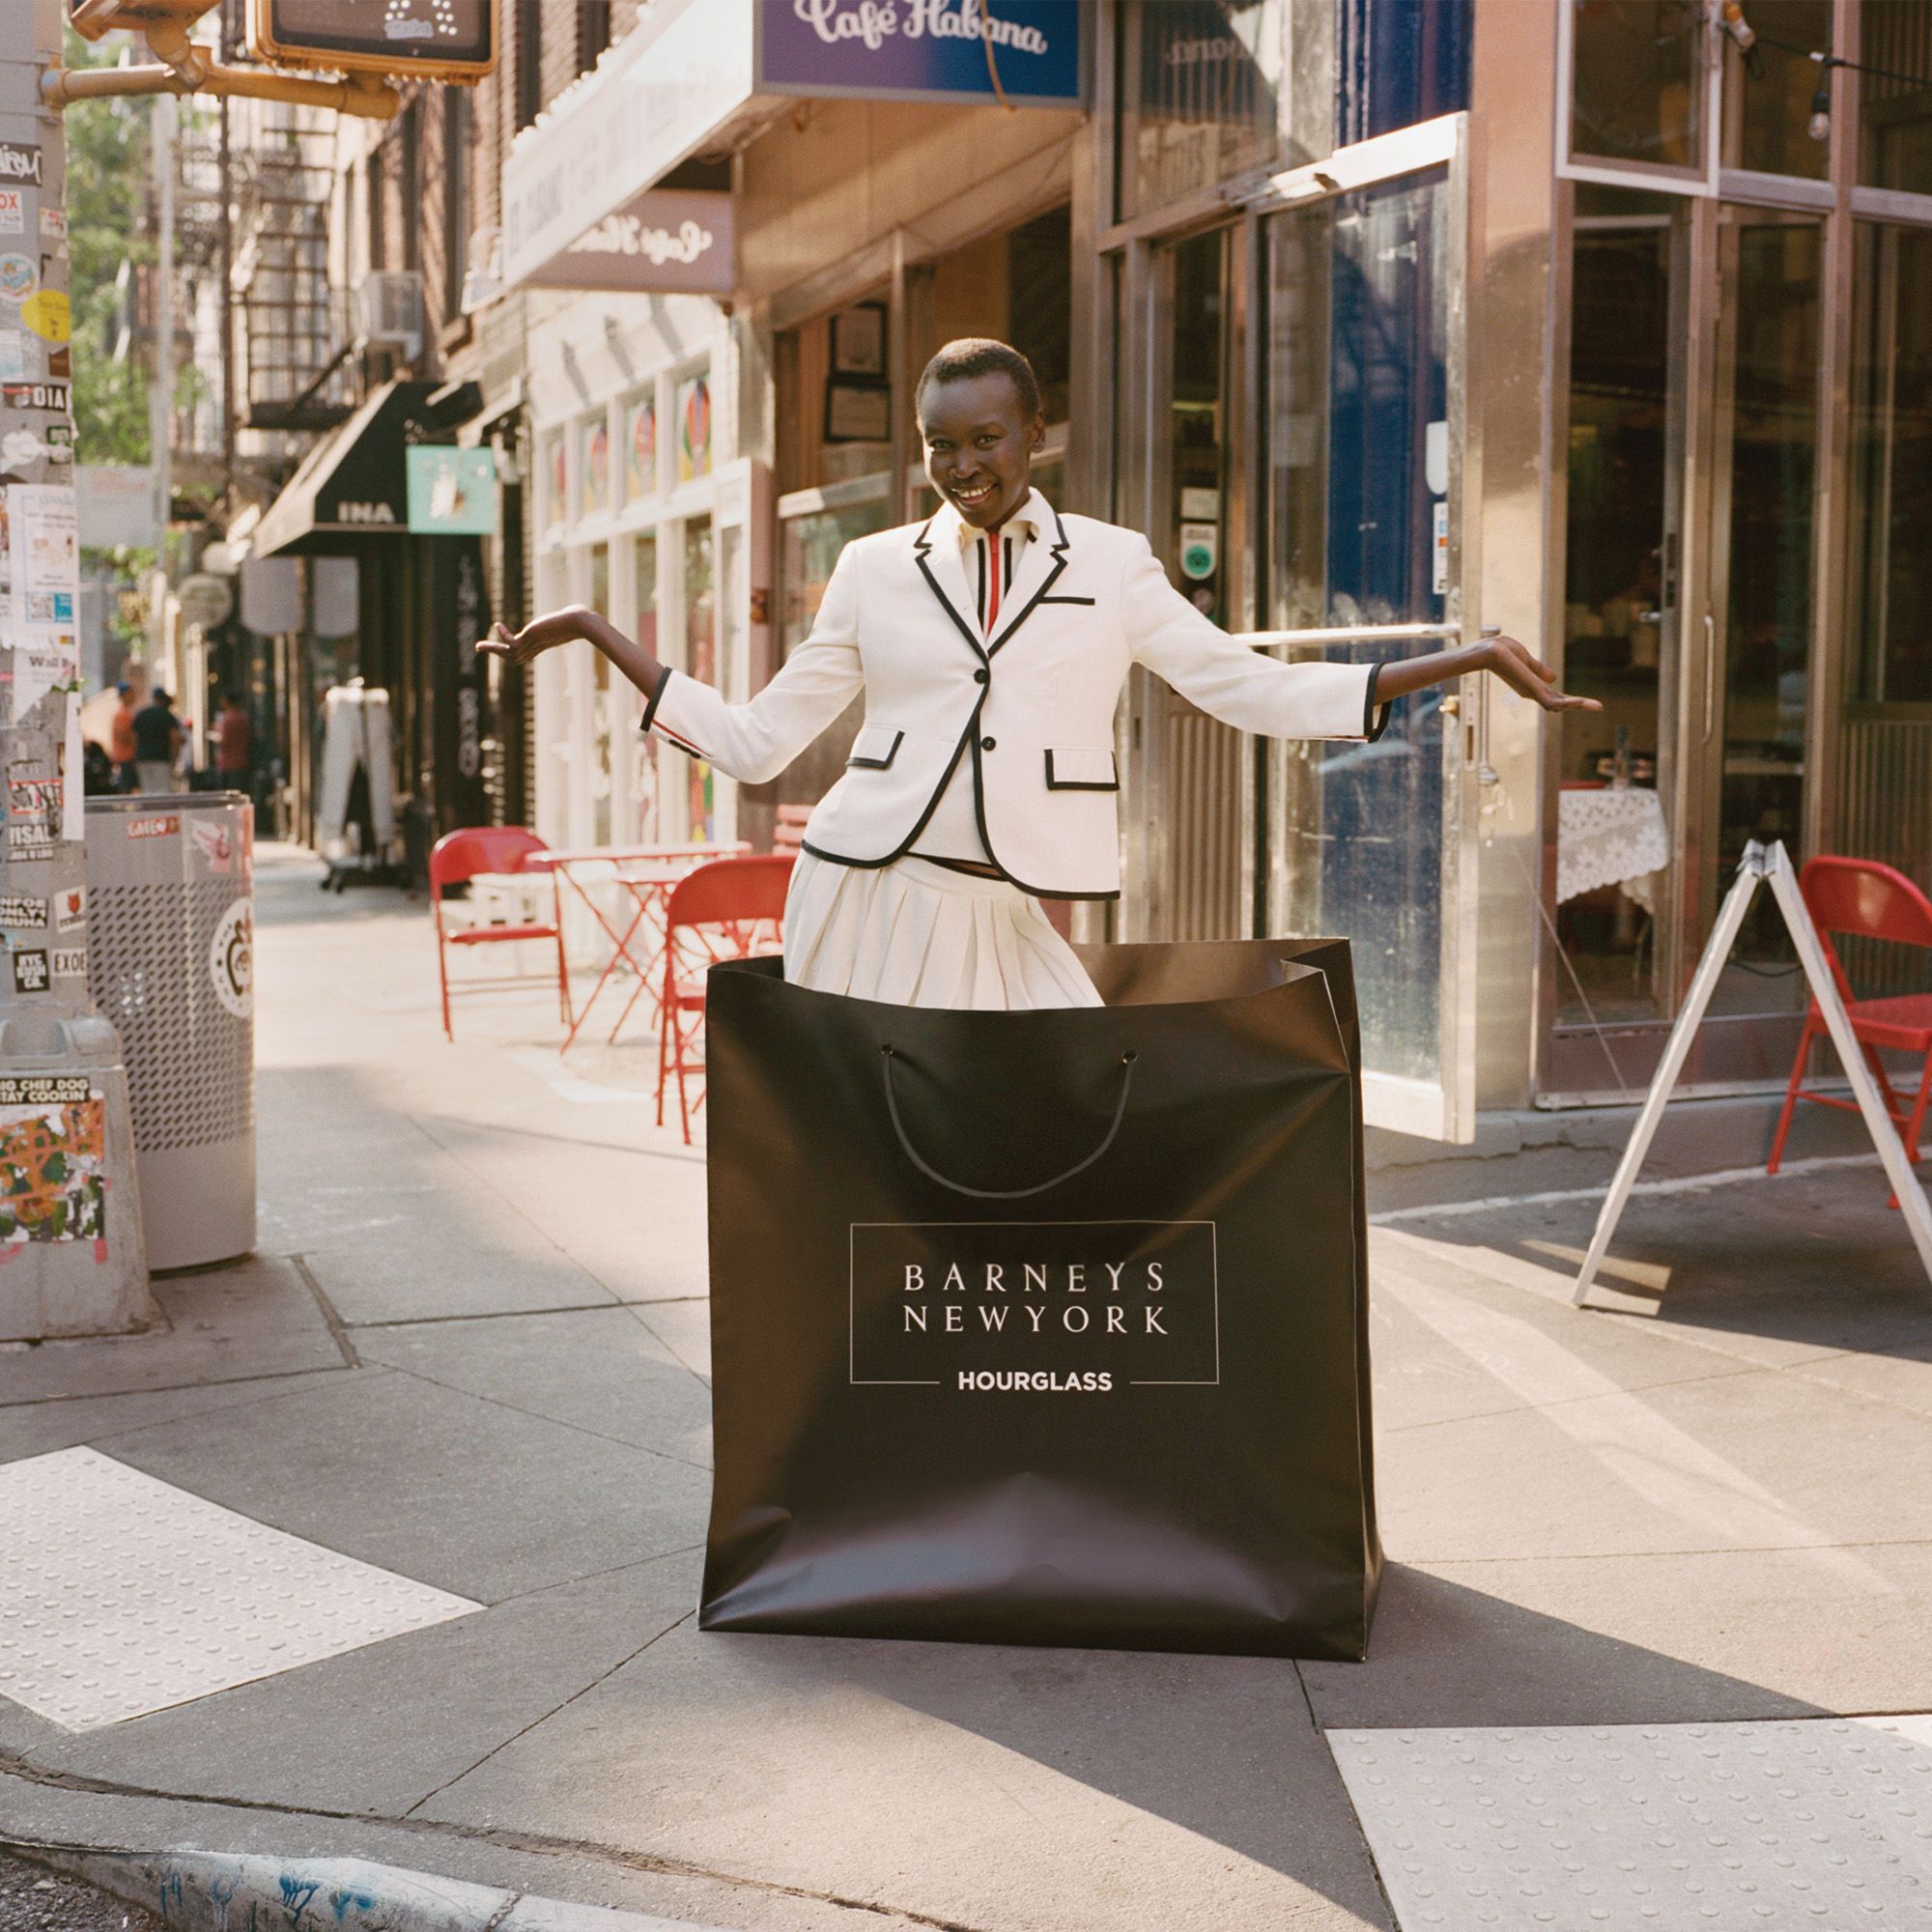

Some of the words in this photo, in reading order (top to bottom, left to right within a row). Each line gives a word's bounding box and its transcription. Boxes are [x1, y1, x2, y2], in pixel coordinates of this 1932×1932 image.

[794, 0, 897, 49] Café
[902, 0, 1048, 55] Habana
[20, 1079, 53, 1092] CHEF
[57, 1079, 89, 1091] DOG
[28, 1090, 85, 1101] COOKIN
[904, 1262, 1164, 1293] BARNEYS
[958, 1371, 1113, 1391] HOURGLASS
